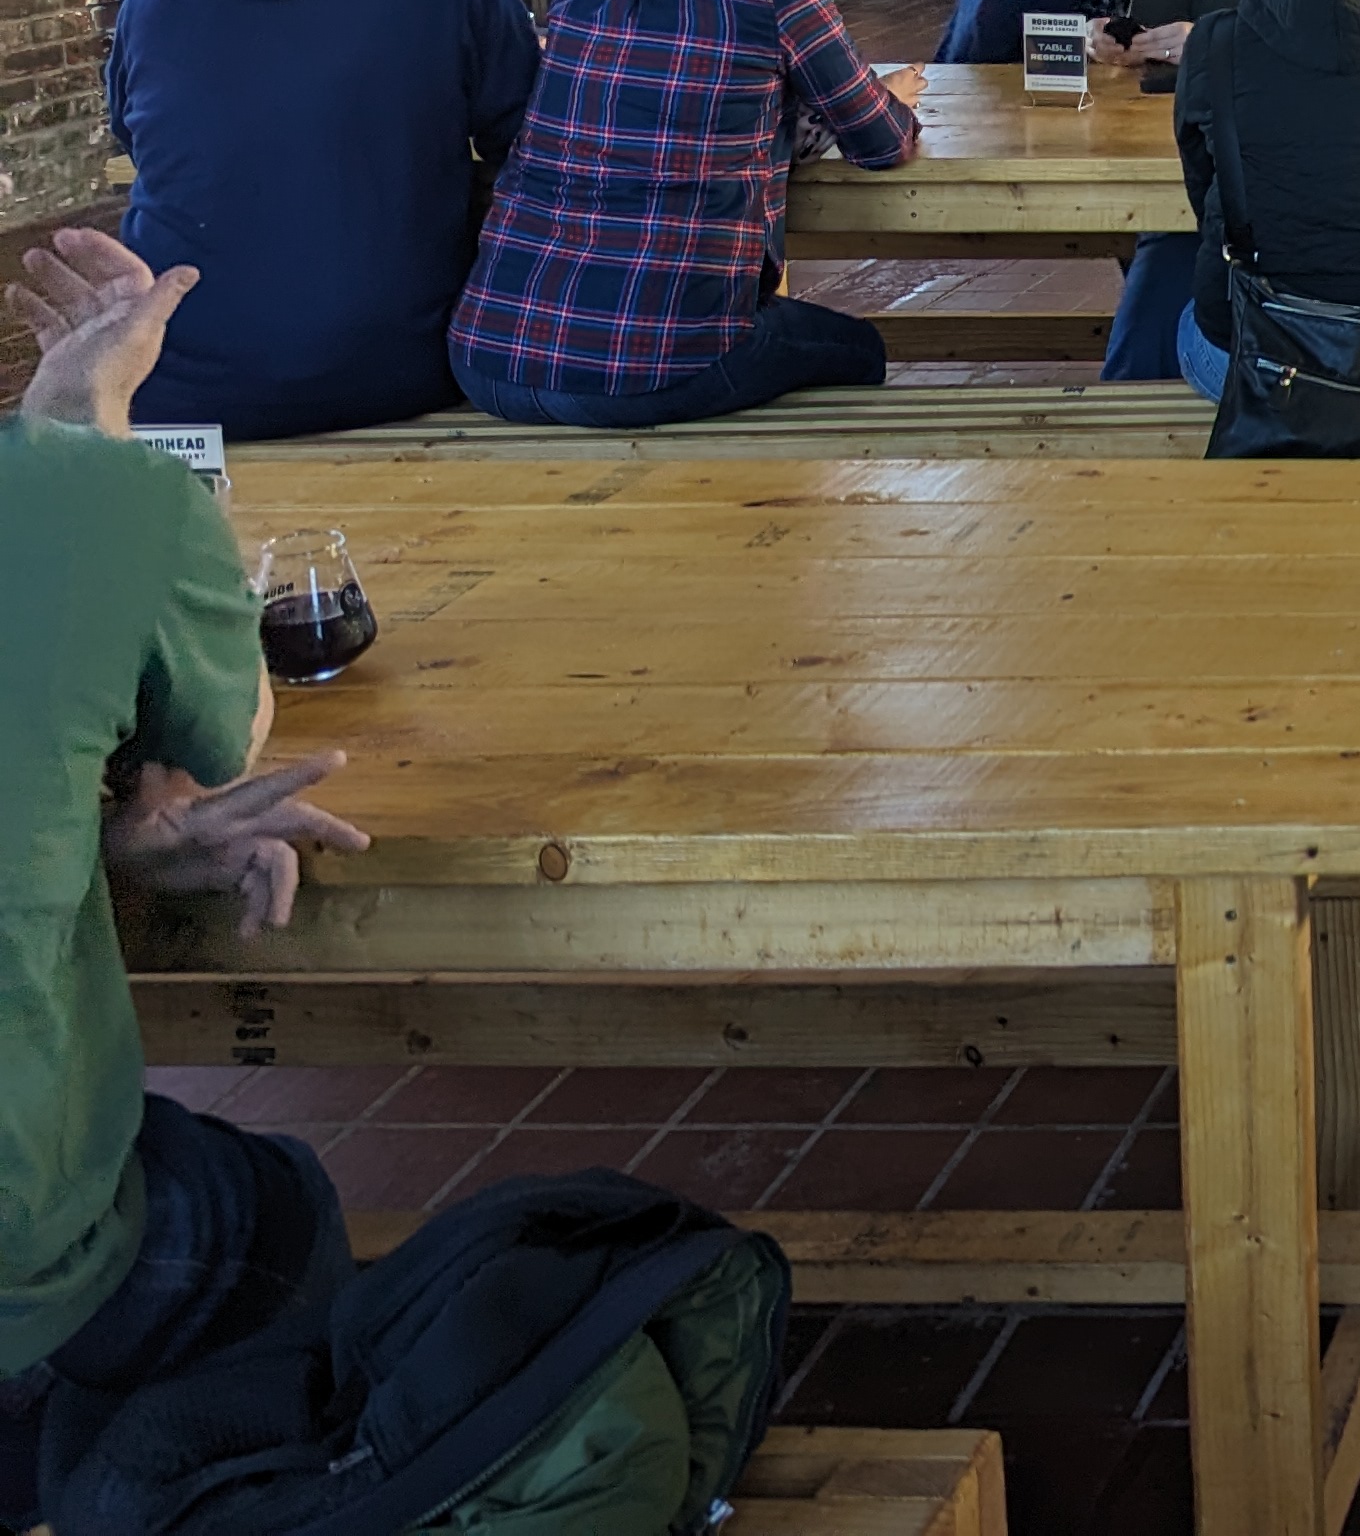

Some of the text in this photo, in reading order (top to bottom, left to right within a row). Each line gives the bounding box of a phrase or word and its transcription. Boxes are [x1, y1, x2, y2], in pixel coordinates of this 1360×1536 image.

[1032, 18, 1078, 27] ROUNDHEAD
[1038, 43, 1073, 52] TABLE
[1030, 53, 1081, 62] RESERVED
[144, 438, 205, 450] DHEAD
